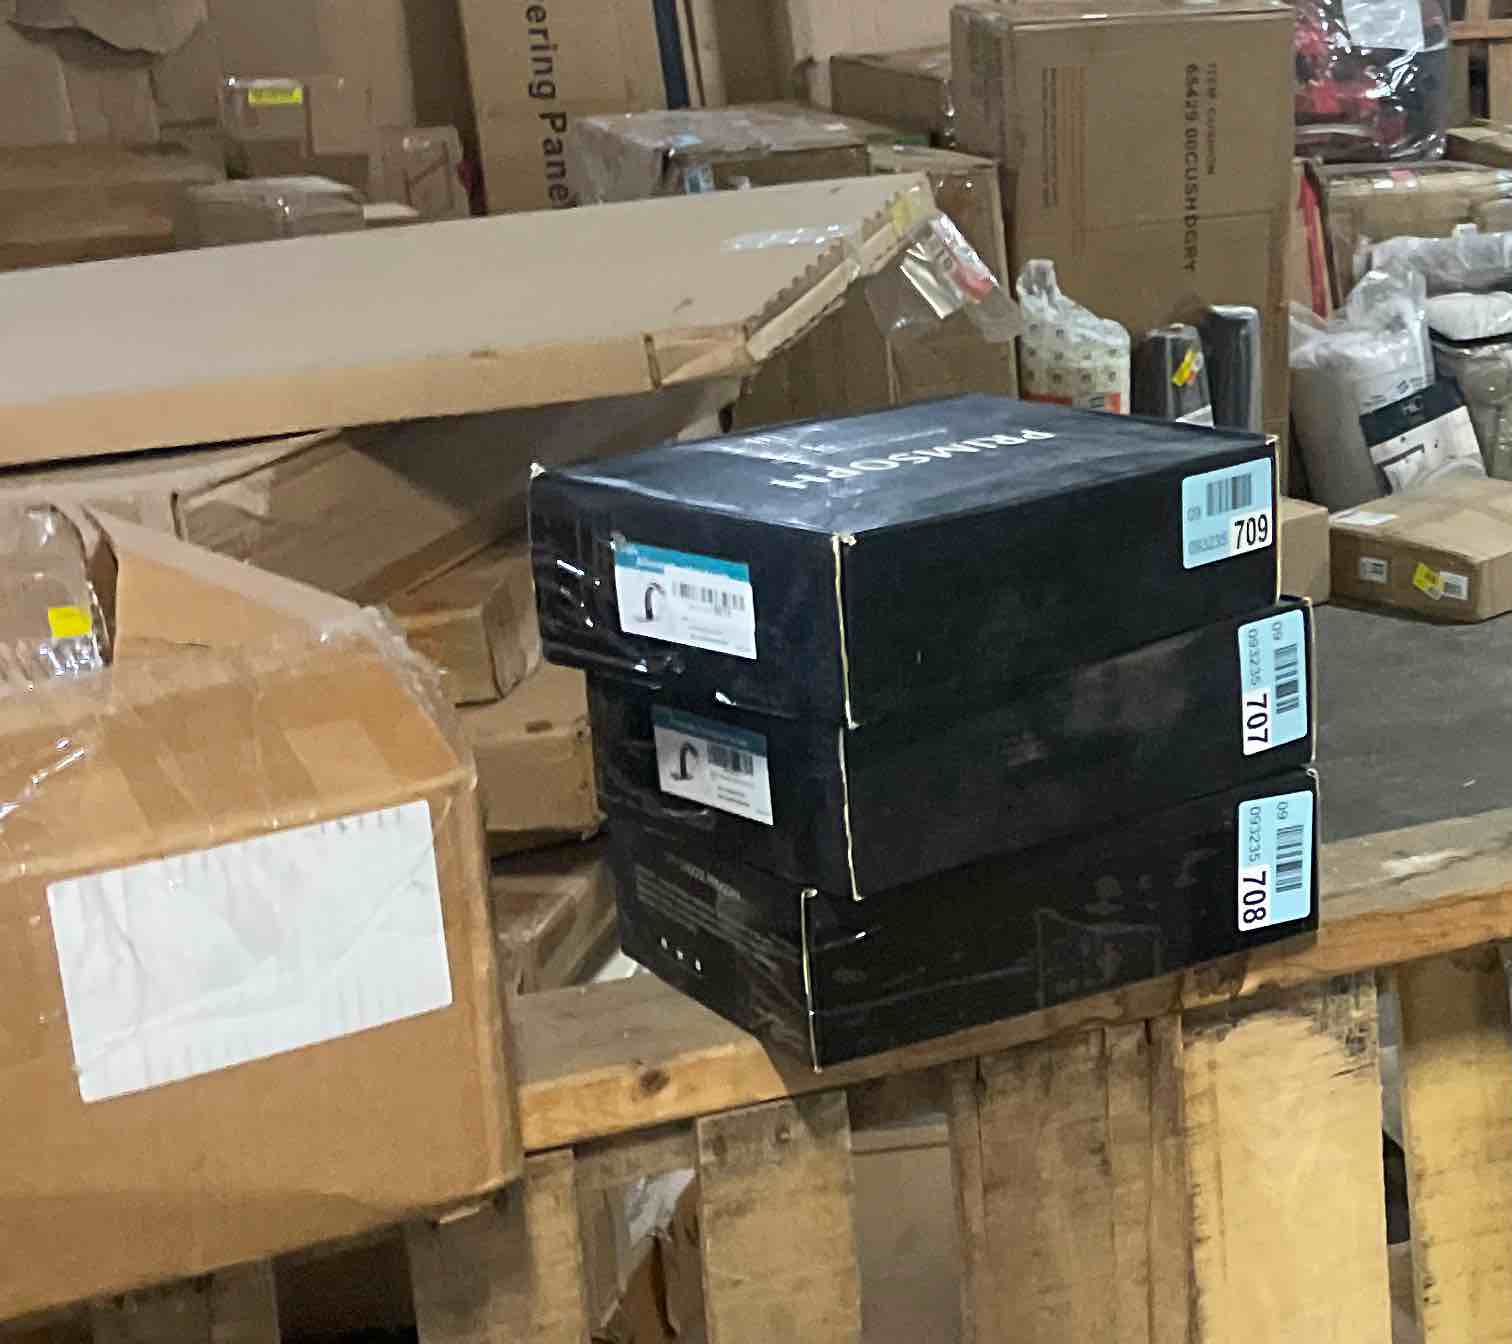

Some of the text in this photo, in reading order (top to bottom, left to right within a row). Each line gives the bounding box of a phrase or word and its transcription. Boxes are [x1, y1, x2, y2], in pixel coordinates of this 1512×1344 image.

[538, 111, 577, 208] Pane
[1234, 513, 1269, 550] 709
[1246, 693, 1268, 743] 707
[1242, 870, 1267, 924] 708
